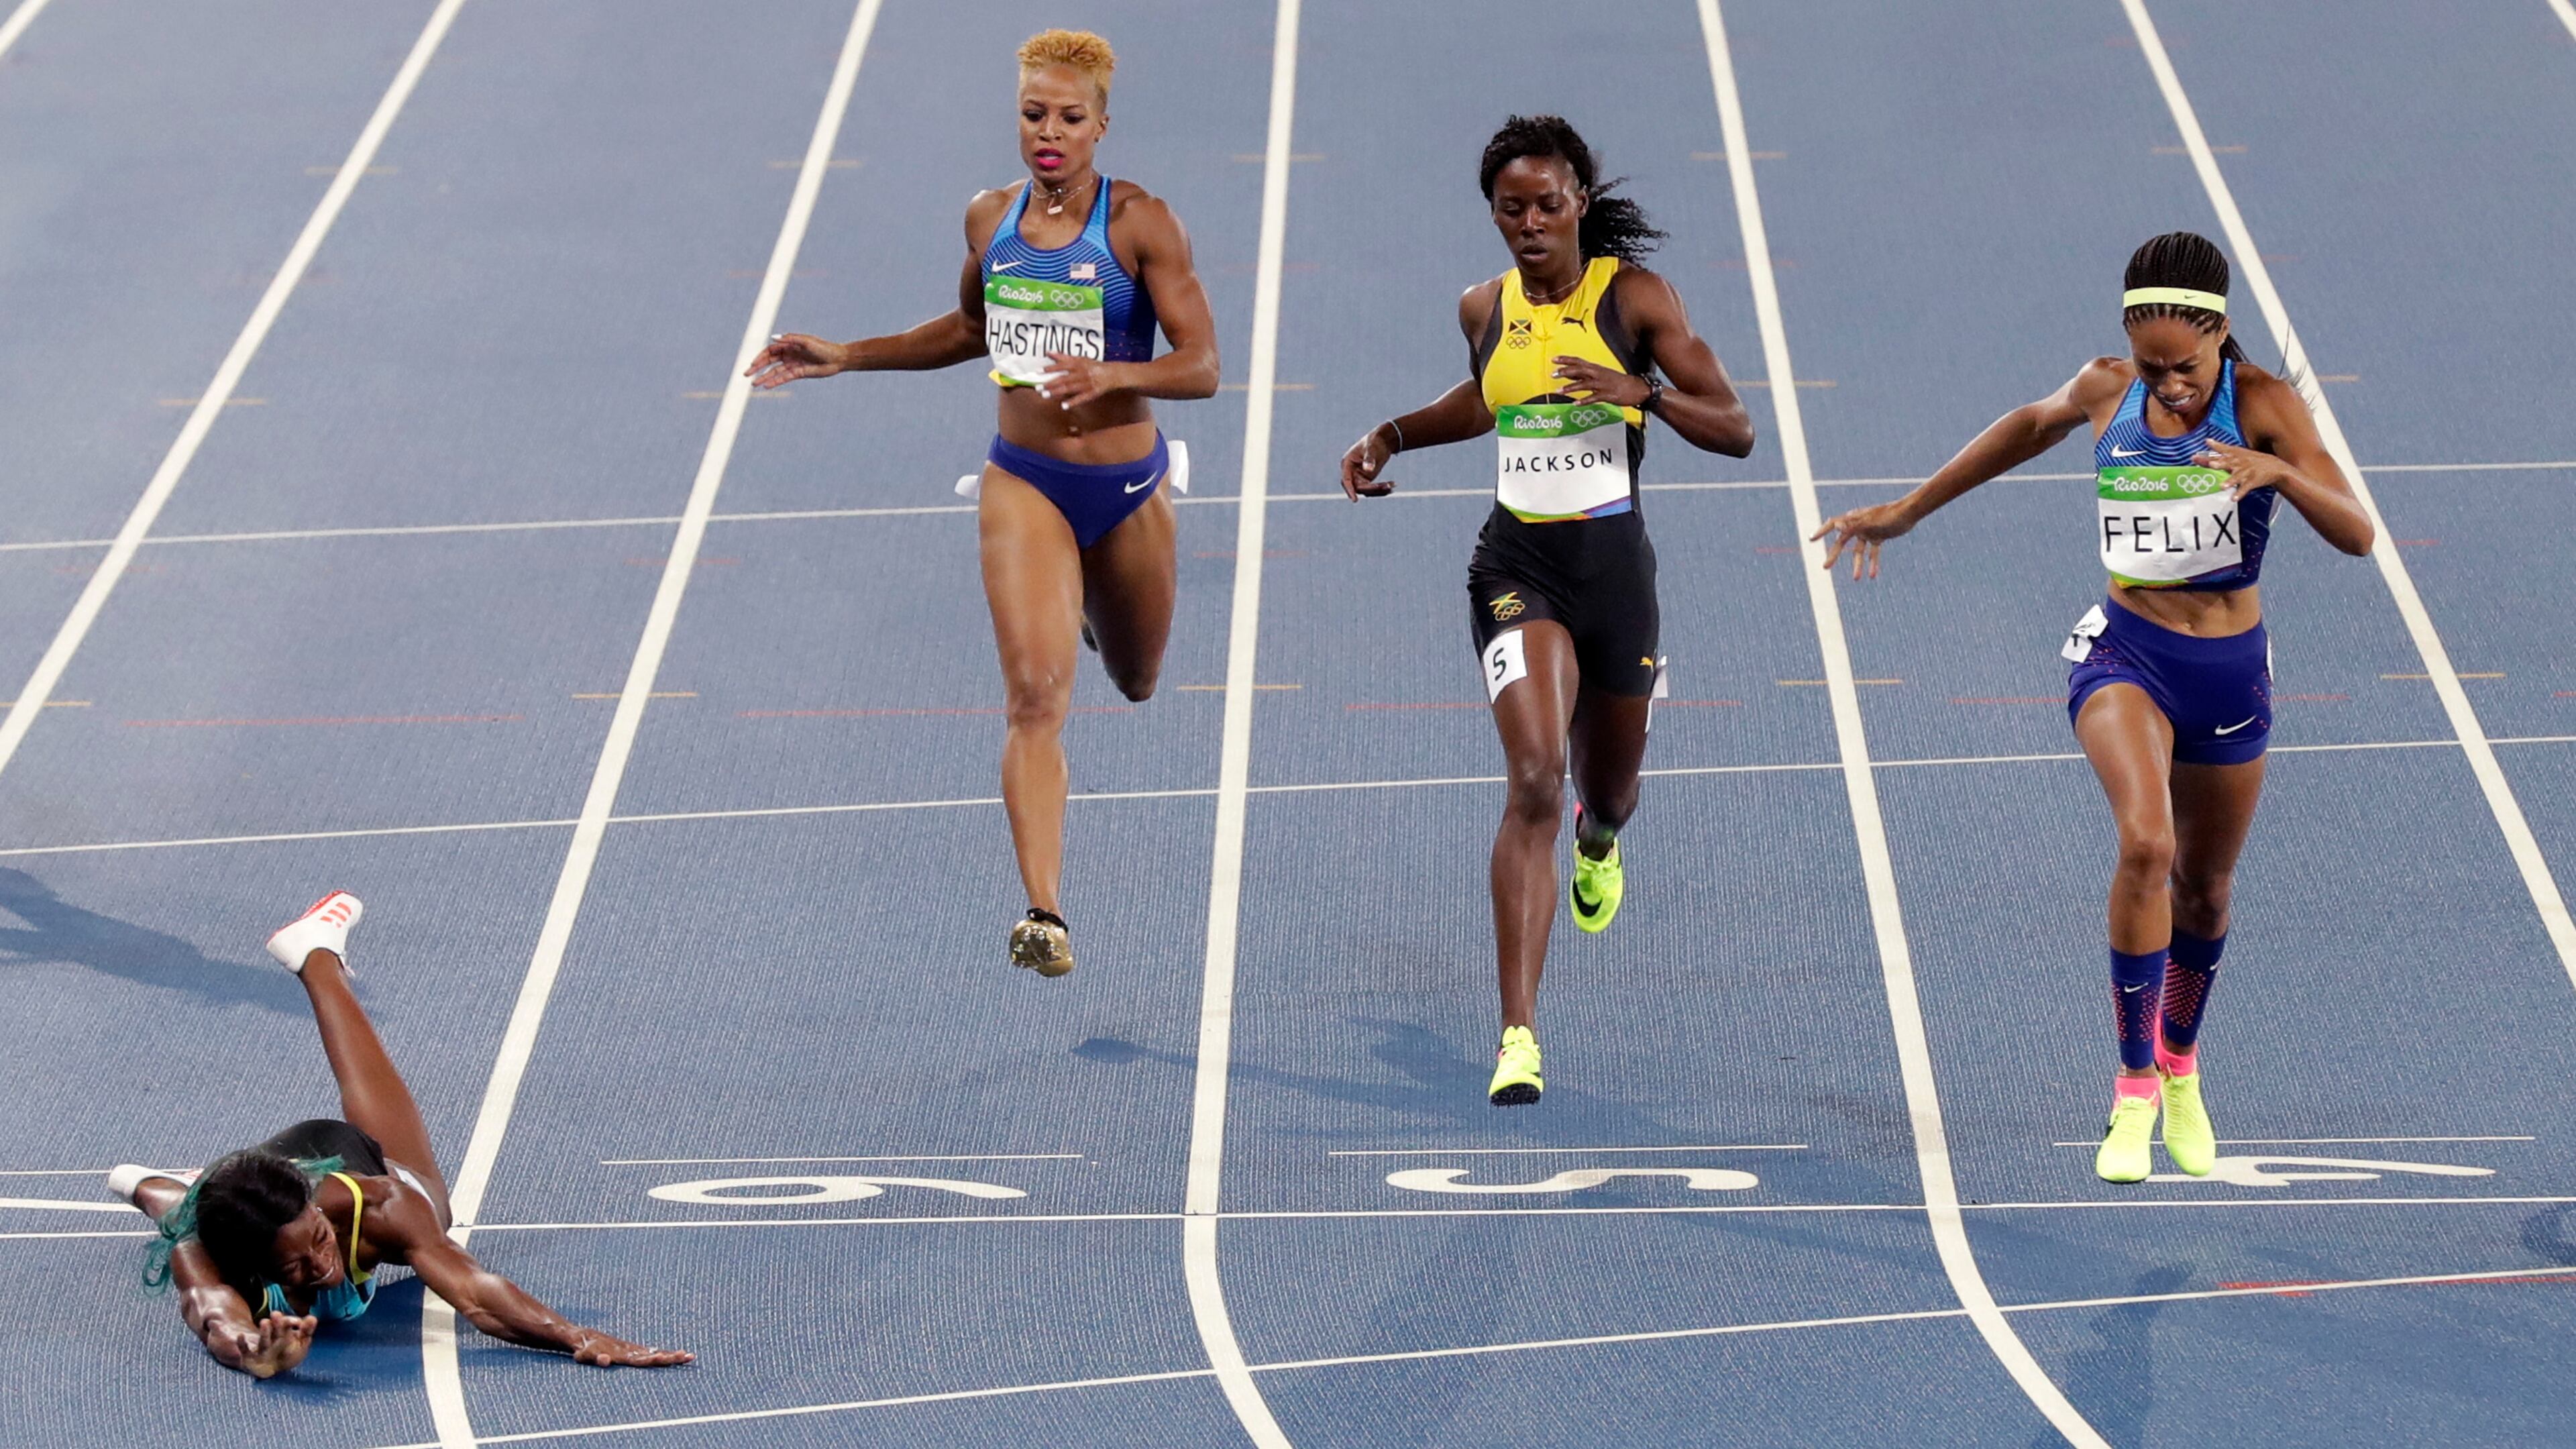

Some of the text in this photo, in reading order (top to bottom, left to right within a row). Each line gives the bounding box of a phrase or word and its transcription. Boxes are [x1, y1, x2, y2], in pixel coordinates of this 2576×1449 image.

[999, 284, 1043, 303] Rio2016
[988, 317, 1100, 360] HASTINGS
[1514, 415, 1563, 430] Rio2016
[1504, 448, 1613, 473] JACKSON
[2113, 476, 2169, 492] Rio2016
[2104, 510, 2237, 553] FELIX
[1493, 647, 1507, 682] 5
[1385, 1168, 1760, 1193] 5
